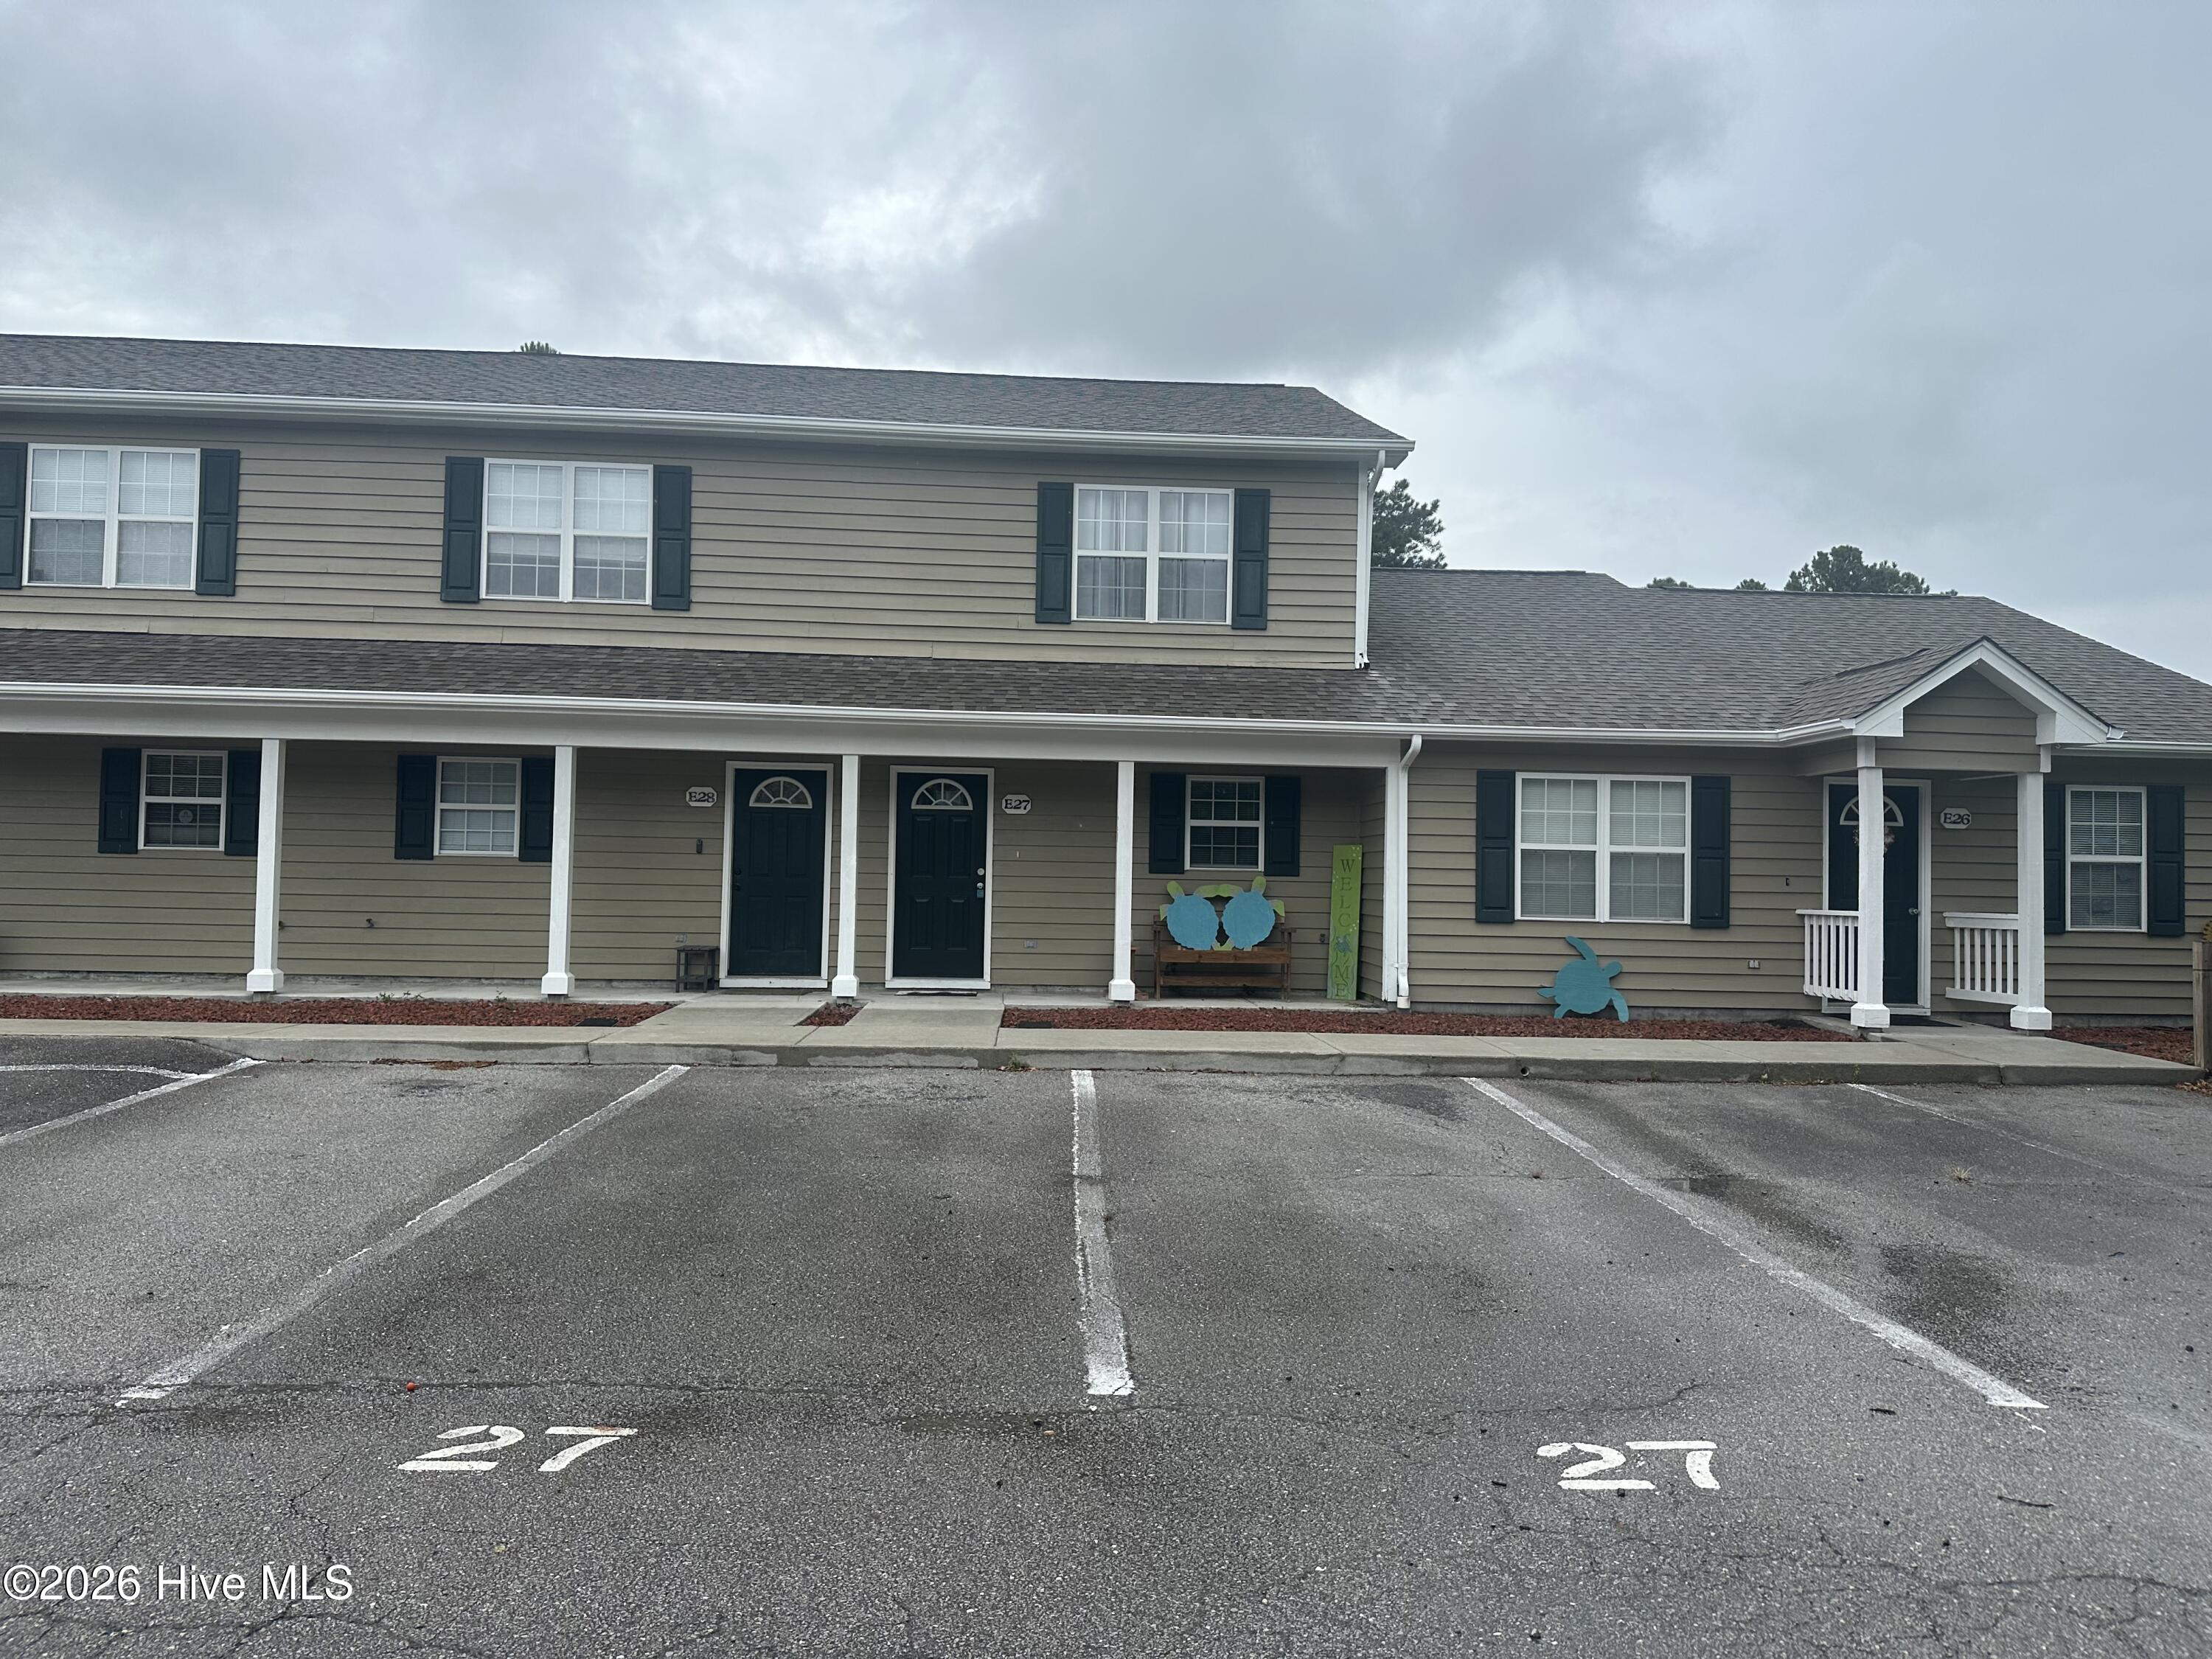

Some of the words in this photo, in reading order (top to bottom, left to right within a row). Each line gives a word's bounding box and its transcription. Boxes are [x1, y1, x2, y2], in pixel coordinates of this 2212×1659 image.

[689, 792, 714, 802] E28
[1004, 799, 1030, 810] E27
[1944, 813, 1970, 825] E26
[1333, 858, 1355, 998] WELCME
[397, 1425, 638, 1471] 27
[1537, 1441, 1721, 1489] 27
